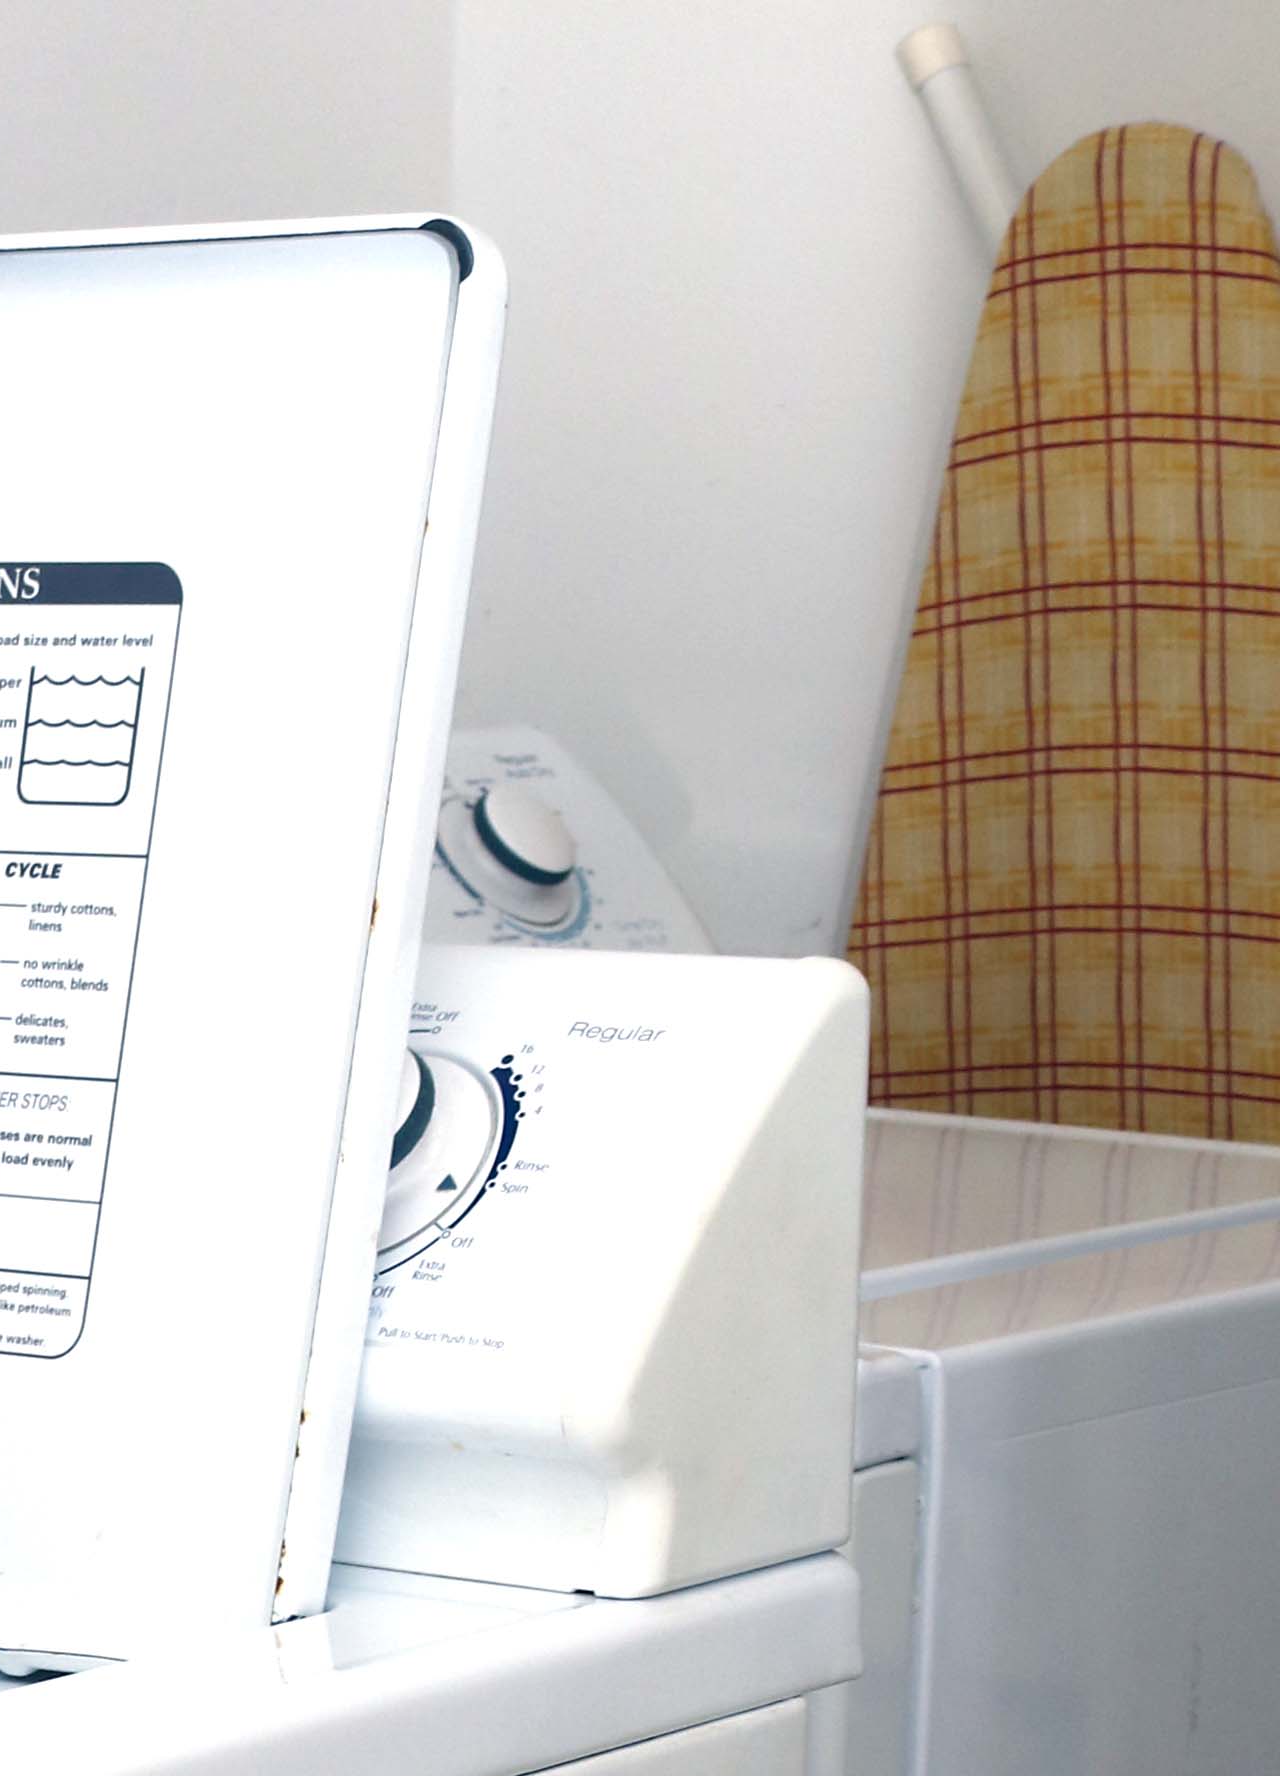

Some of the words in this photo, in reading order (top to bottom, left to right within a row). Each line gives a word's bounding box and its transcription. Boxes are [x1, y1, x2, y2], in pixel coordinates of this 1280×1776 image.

[24, 634, 48, 646] size
[52, 634, 76, 646] and
[81, 636, 118, 646] water
[122, 634, 153, 646] level
[6, 862, 62, 878] CYCLE
[32, 902, 68, 916] sturdy
[28, 920, 62, 932] linens
[24, 960, 38, 969] no
[42, 960, 84, 972] wrinkle
[70, 978, 108, 991] blends
[436, 1012, 459, 1022] Off
[568, 1022, 666, 1042] Regular
[14, 1035, 65, 1046] sweaters
[24, 1134, 43, 1143] are
[48, 1135, 92, 1146] normal
[2, 1152, 29, 1165] load
[32, 1156, 73, 1170] evenly
[501, 1182, 528, 1194] Spin
[452, 1238, 474, 1248] Off
[18, 1304, 71, 1316] petroleum
